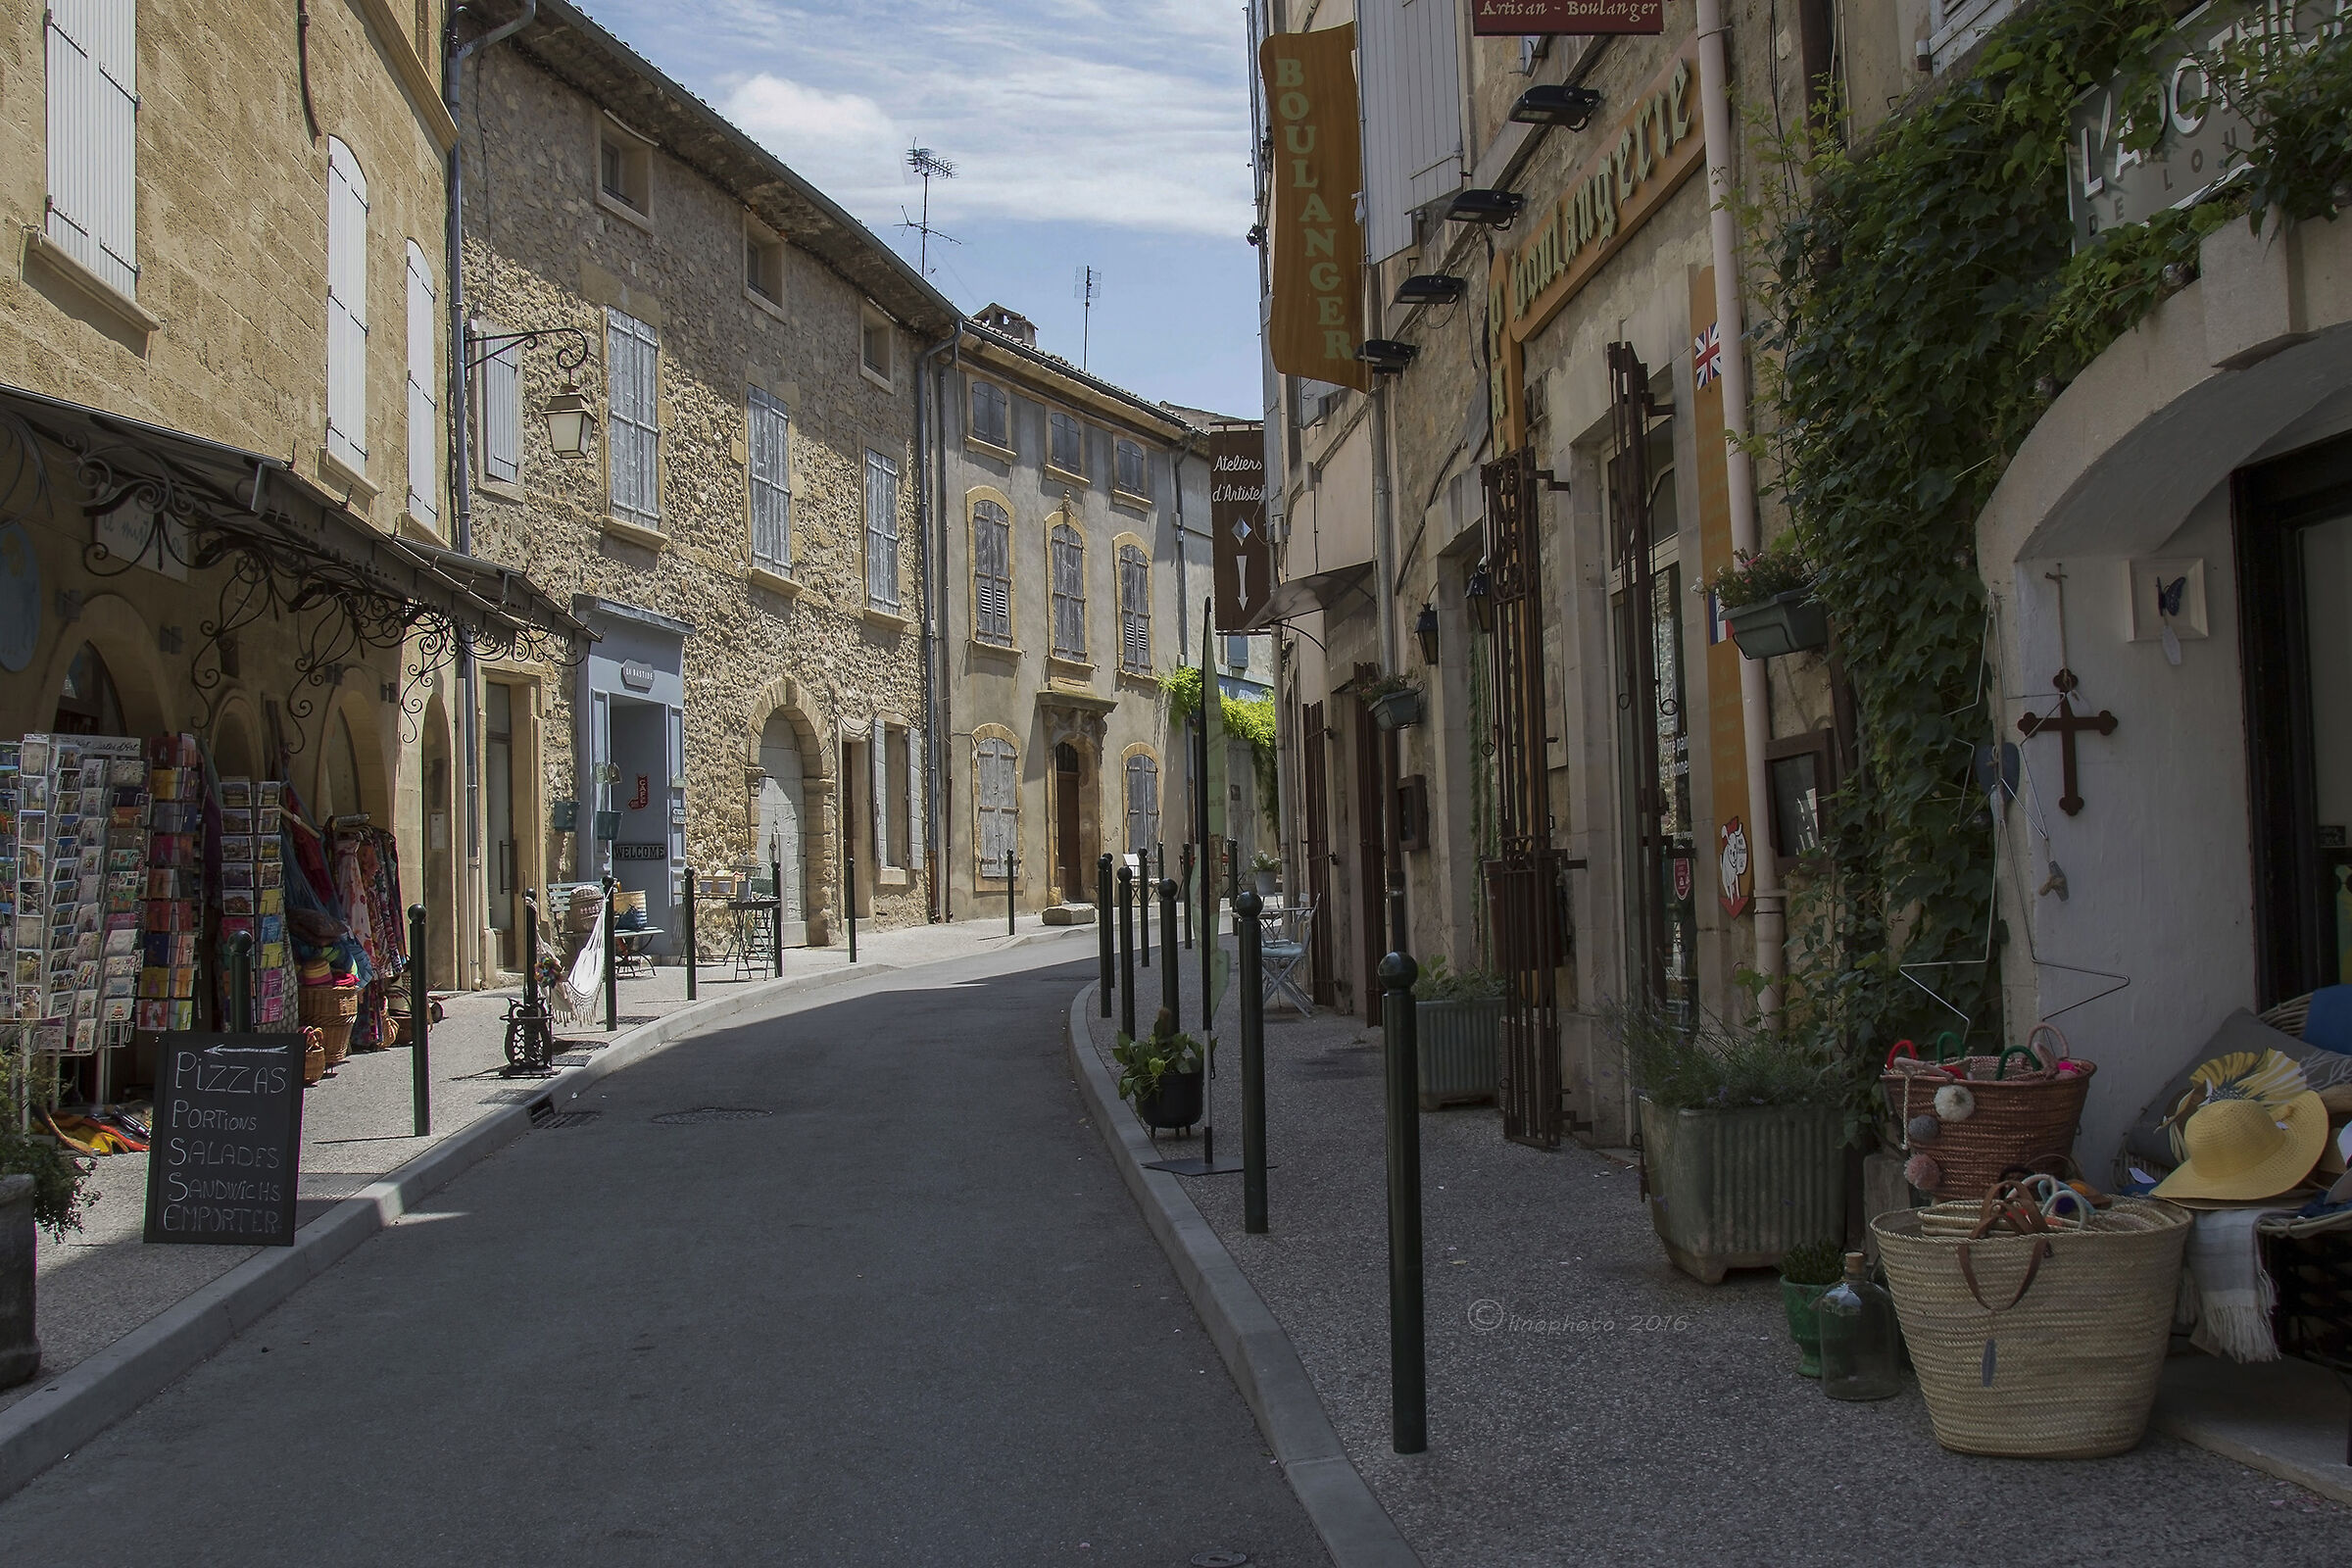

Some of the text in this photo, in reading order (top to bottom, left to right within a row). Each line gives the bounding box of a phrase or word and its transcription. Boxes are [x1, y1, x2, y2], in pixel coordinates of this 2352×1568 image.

[1480, 0, 1547, 16] Artisan
[1567, 0, 1658, 23] Boulanger
[1275, 58, 1353, 360] BOULANGER
[1213, 455, 1262, 472] Ateliers
[614, 846, 664, 858] WELCOME
[168, 1137, 280, 1170] SALADES
[163, 1203, 280, 1234] EMPORTER
